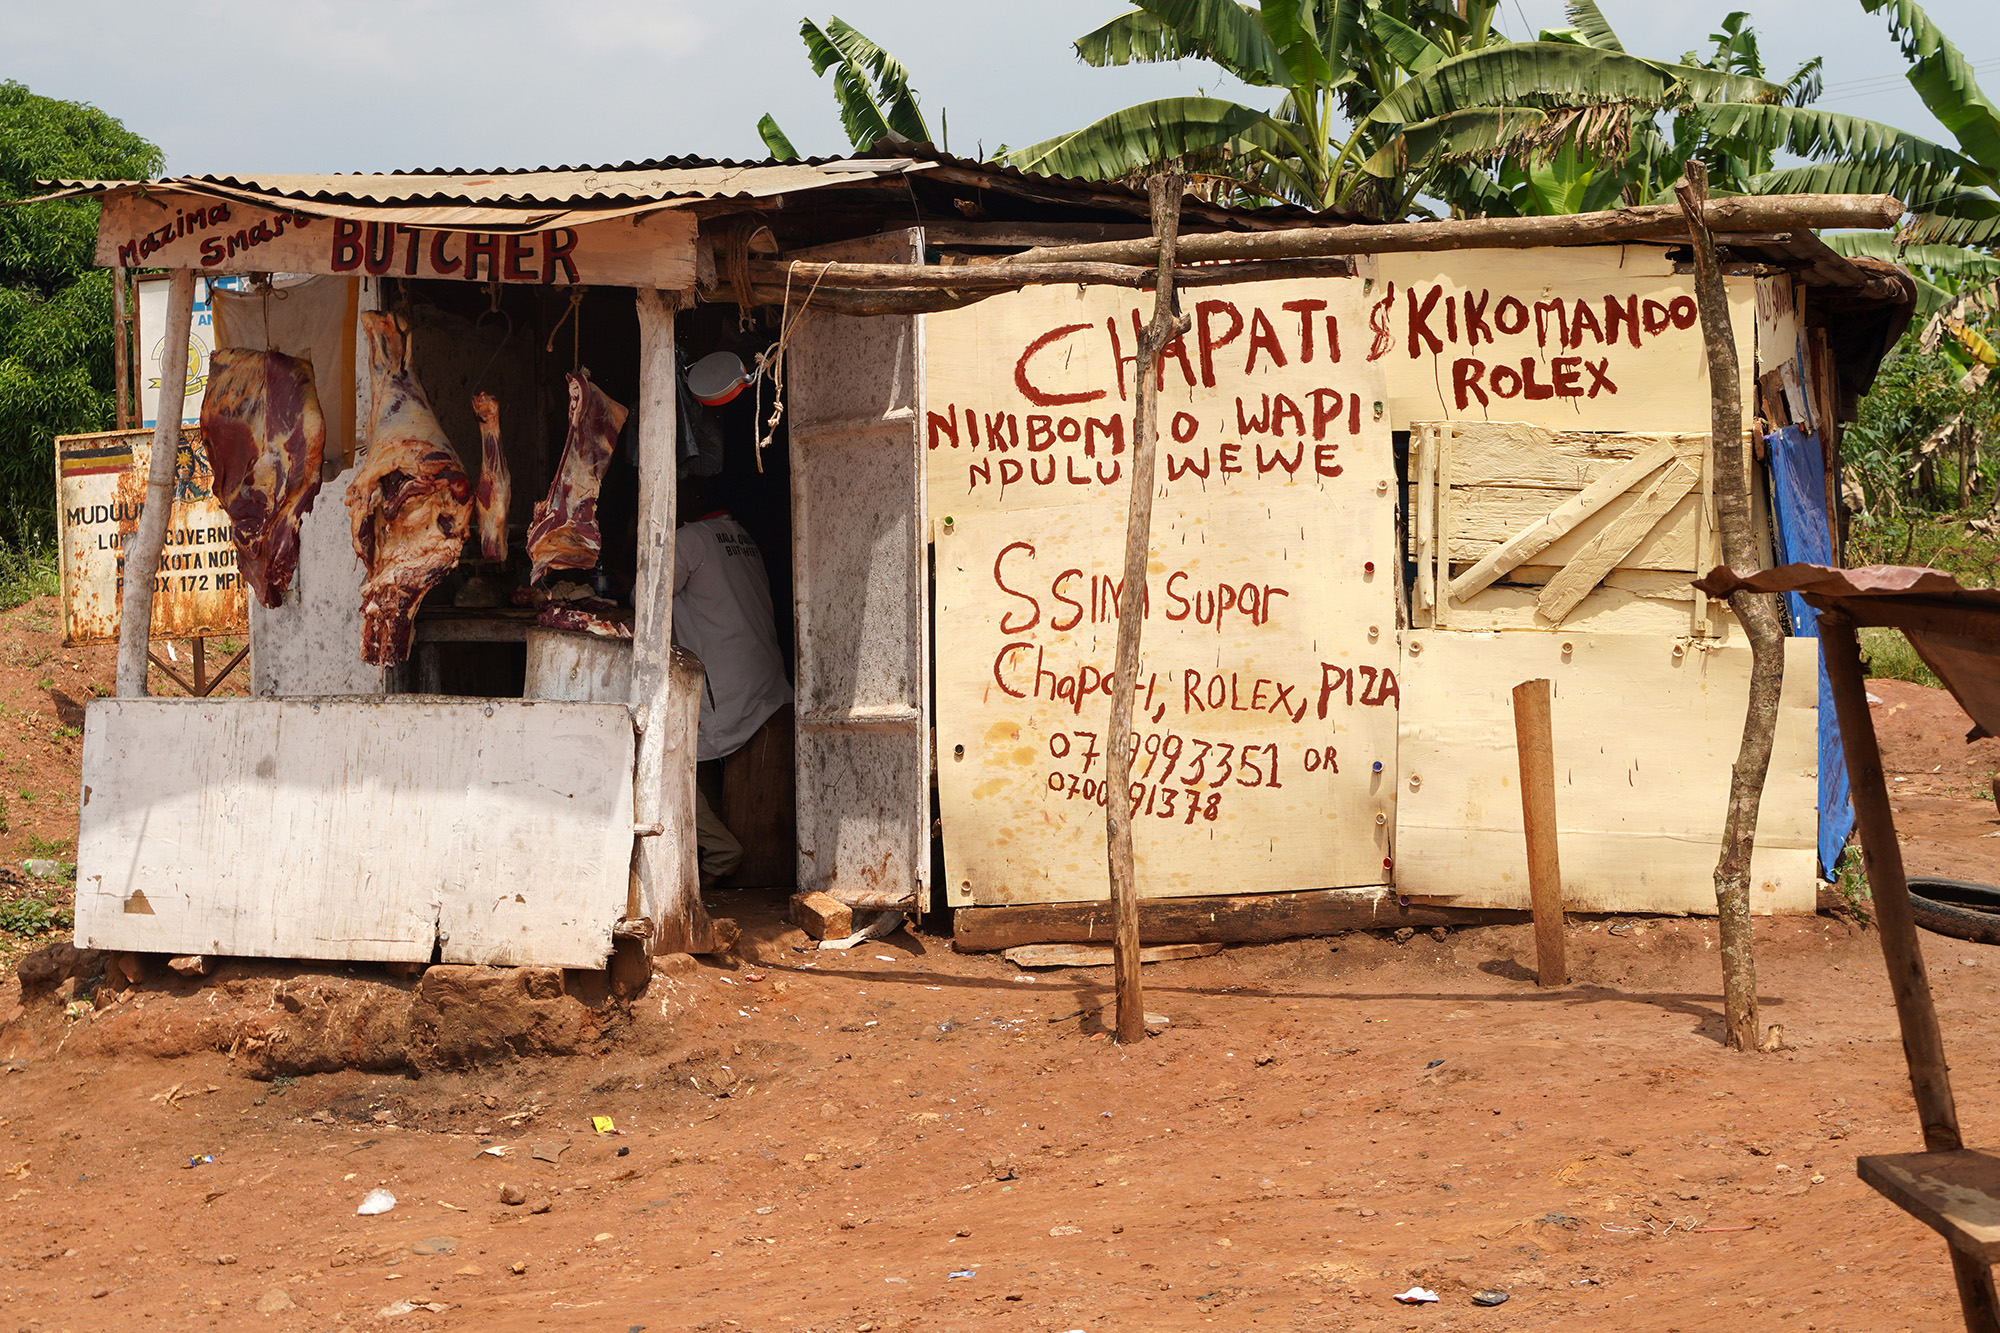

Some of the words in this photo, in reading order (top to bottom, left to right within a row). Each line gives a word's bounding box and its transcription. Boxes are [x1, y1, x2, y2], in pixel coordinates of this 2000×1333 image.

[118, 202, 231, 267] Mazima
[330, 217, 579, 285] BUTCHER
[1015, 299, 1340, 407] CHAPATI
[1406, 284, 1698, 360] KIKOMANDO
[1452, 356, 1618, 412] ROLEX
[927, 403, 1199, 459] NIKIBOMO
[1235, 388, 1362, 442] WAPI
[968, 453, 1122, 488] NDULU
[1166, 442, 1343, 483] WEWE
[181, 575, 208, 592] 172
[1183, 668, 1308, 723] ROLEX,
[1317, 661, 1400, 719] PIZA
[1048, 730, 1283, 789] 079993351
[1304, 745, 1339, 774] OR
[1047, 771, 1222, 825] 070091378
